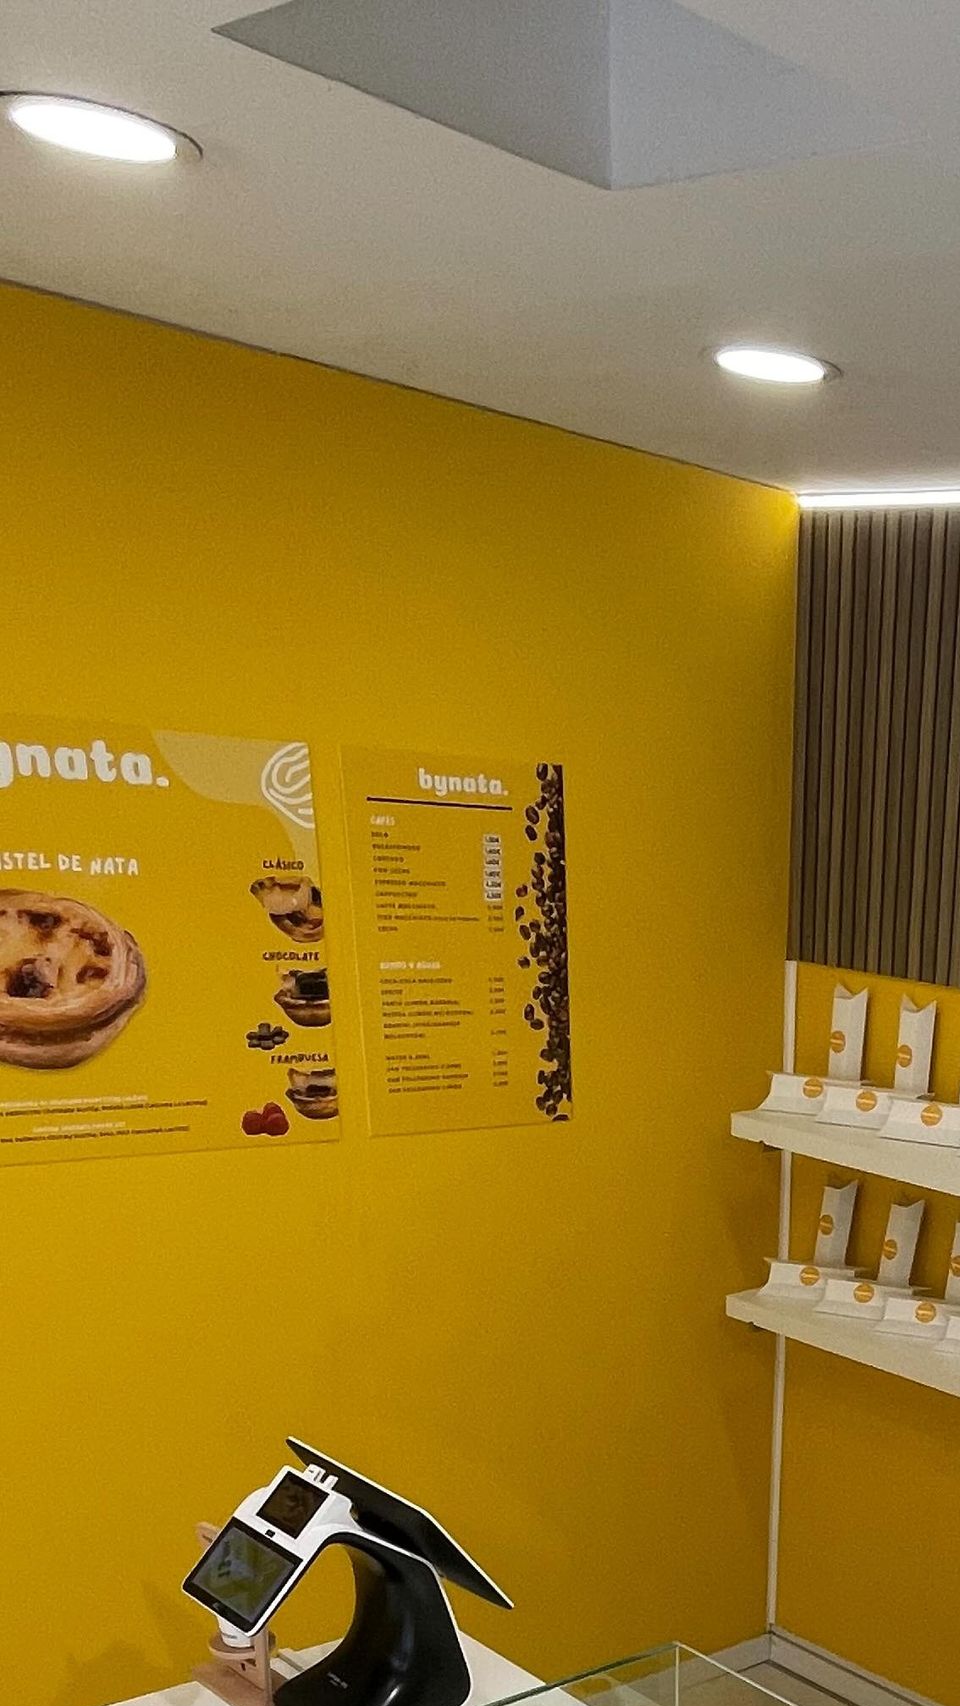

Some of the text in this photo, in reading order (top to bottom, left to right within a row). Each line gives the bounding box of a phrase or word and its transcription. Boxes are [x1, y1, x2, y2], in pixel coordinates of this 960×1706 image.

[418, 767, 509, 796] bynata.
[0, 851, 139, 875] STEL DE NATA
[262, 951, 320, 961] CHOCOLATE
